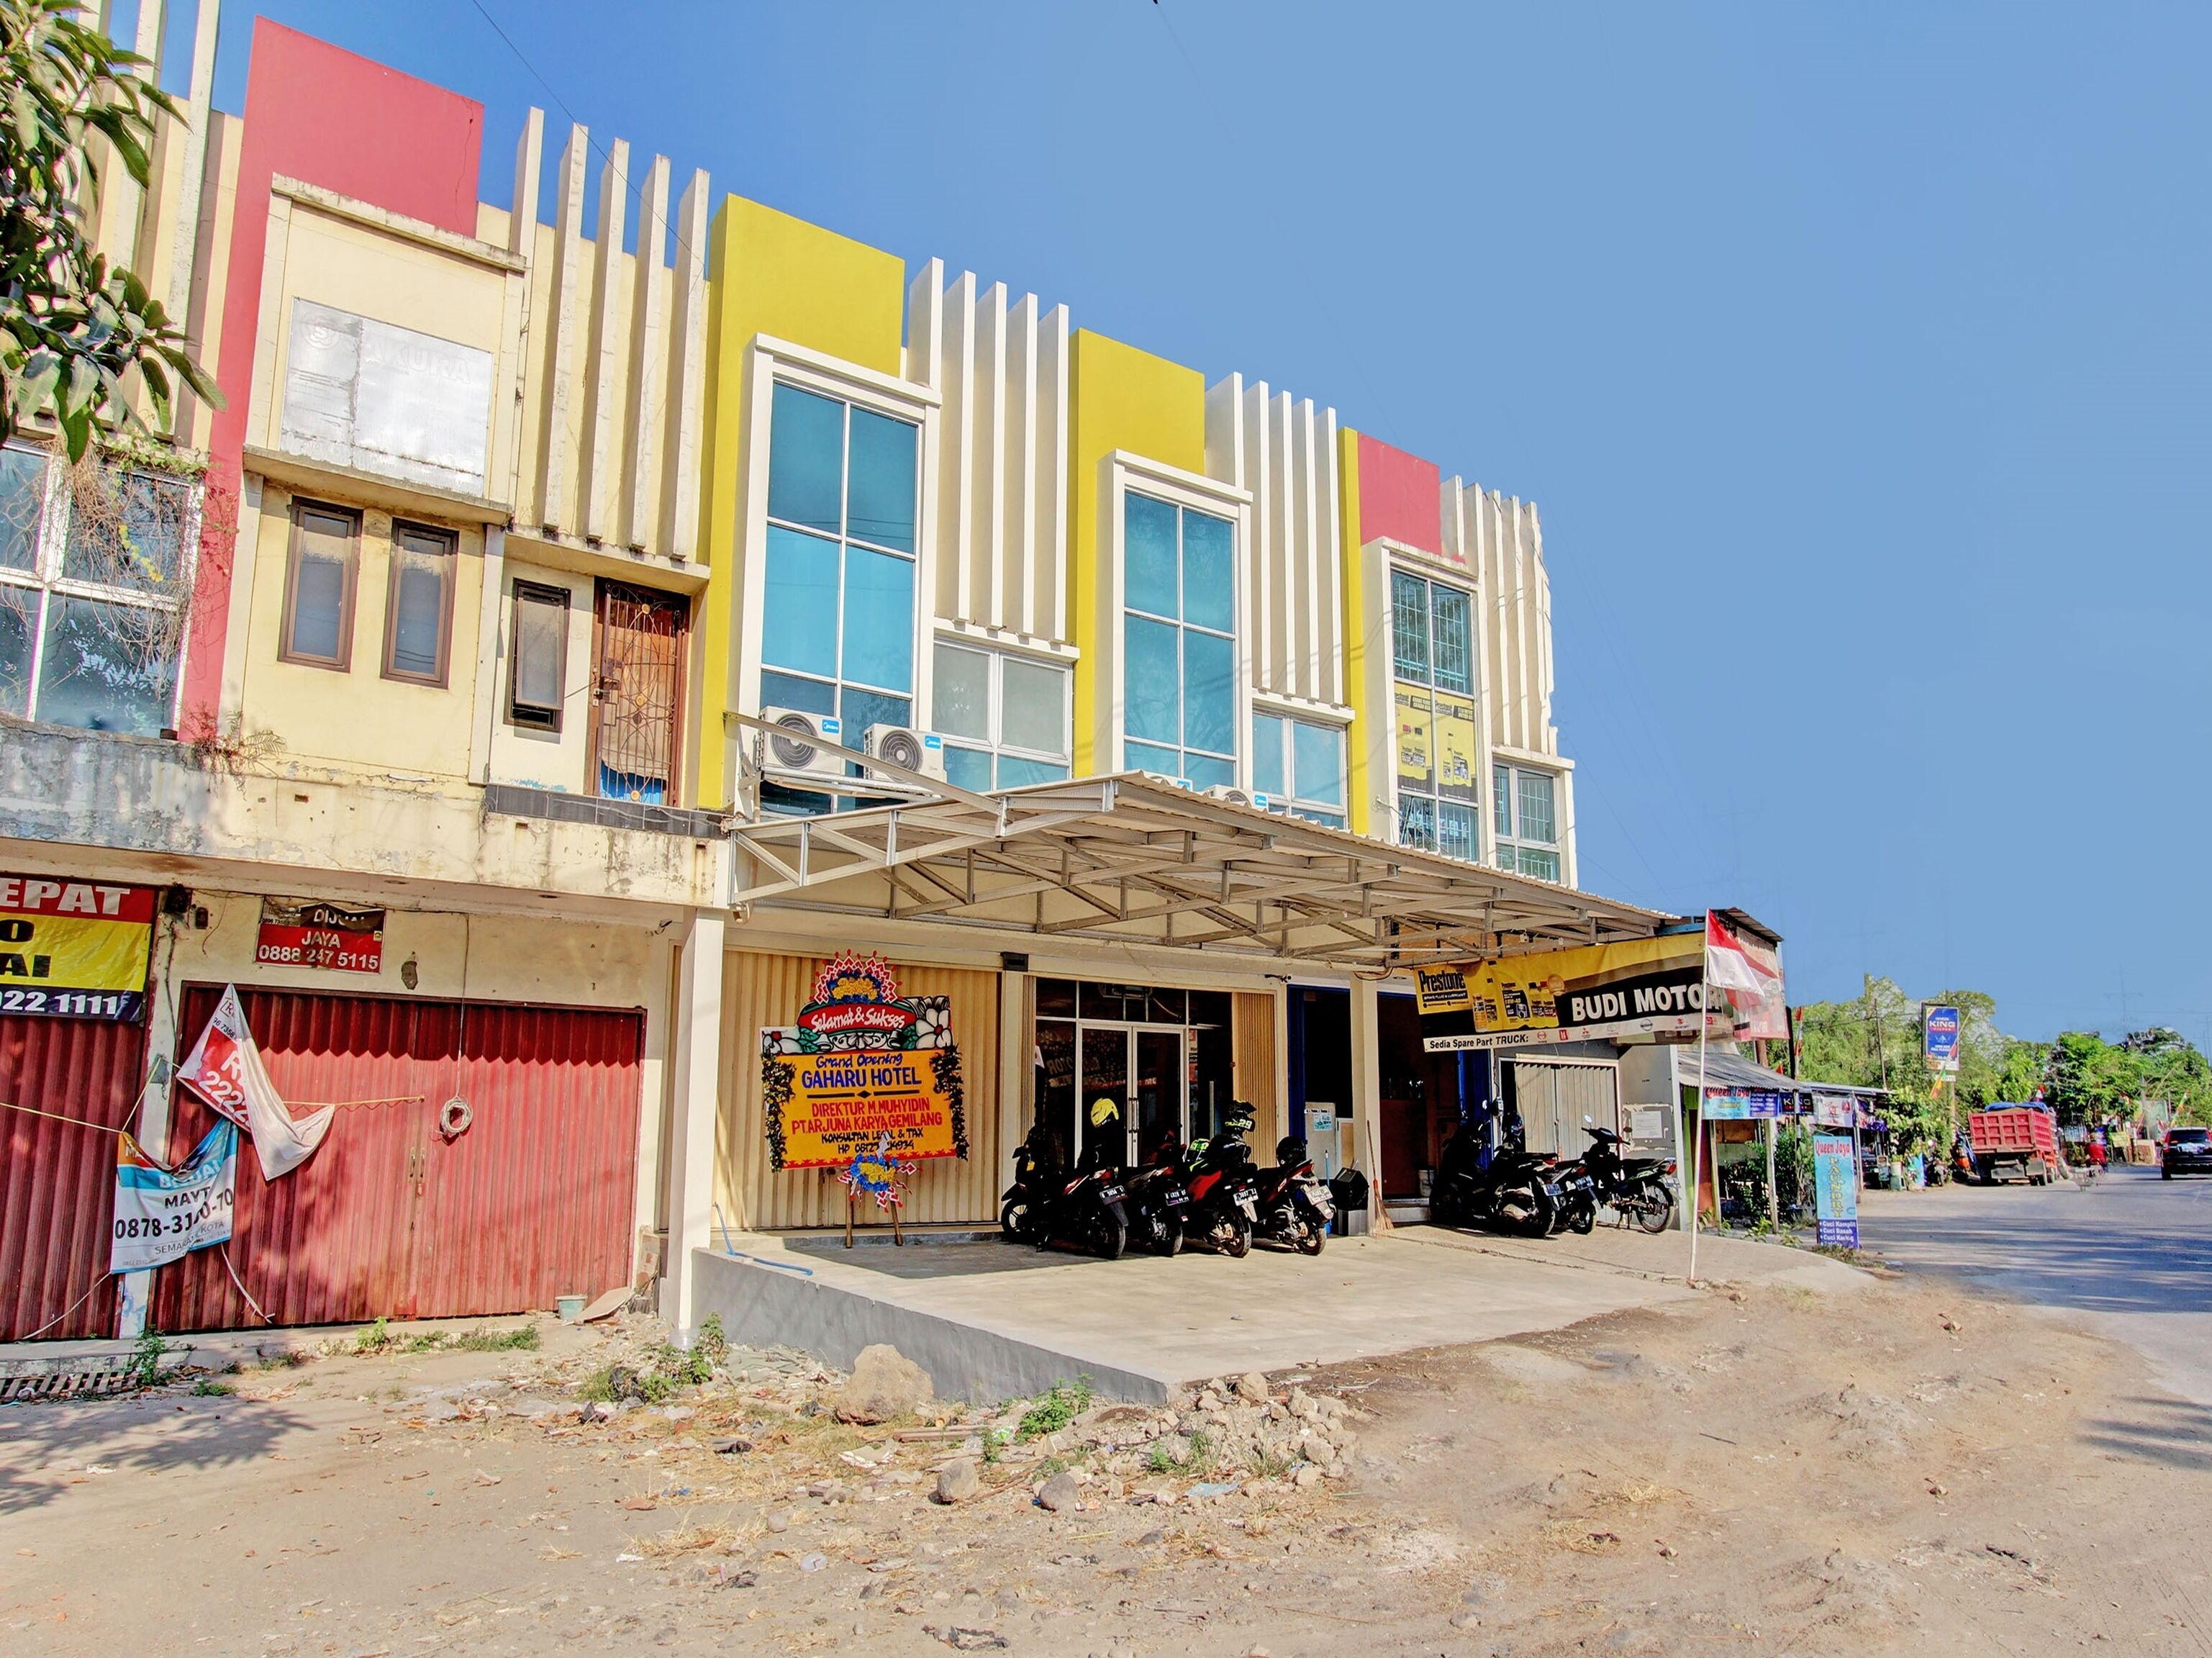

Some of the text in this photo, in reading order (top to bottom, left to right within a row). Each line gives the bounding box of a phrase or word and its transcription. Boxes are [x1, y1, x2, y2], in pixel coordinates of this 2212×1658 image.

[0, 877, 130, 915] EPAT
[302, 930, 340, 948] JAYA
[258, 945, 379, 970] 0888 247 5115
[1418, 969, 1467, 993] Prestone
[0, 990, 118, 1015] 22 1111
[1572, 991, 1628, 1022] BUDI
[1634, 982, 1722, 1013] MOTOR
[811, 1006, 906, 1033] Selamat & Sukses
[1430, 1034, 1529, 1049] Sedia Spare Part TRUCK:
[816, 1053, 903, 1069] Grand Opening
[802, 1067, 922, 1089] GAHARU HOTEL
[812, 1097, 930, 1118] DIREKTUR M.MUHYIDIN
[792, 1112, 943, 1135] PT.ARJUNA KARYA GEMILANG
[821, 1127, 924, 1144] KONSULTAN LEL & TAX
[838, 1144, 850, 1154] HP
[1816, 1139, 1850, 1156] Queen Jaya
[1828, 1156, 1844, 1218] LAUNDRY
